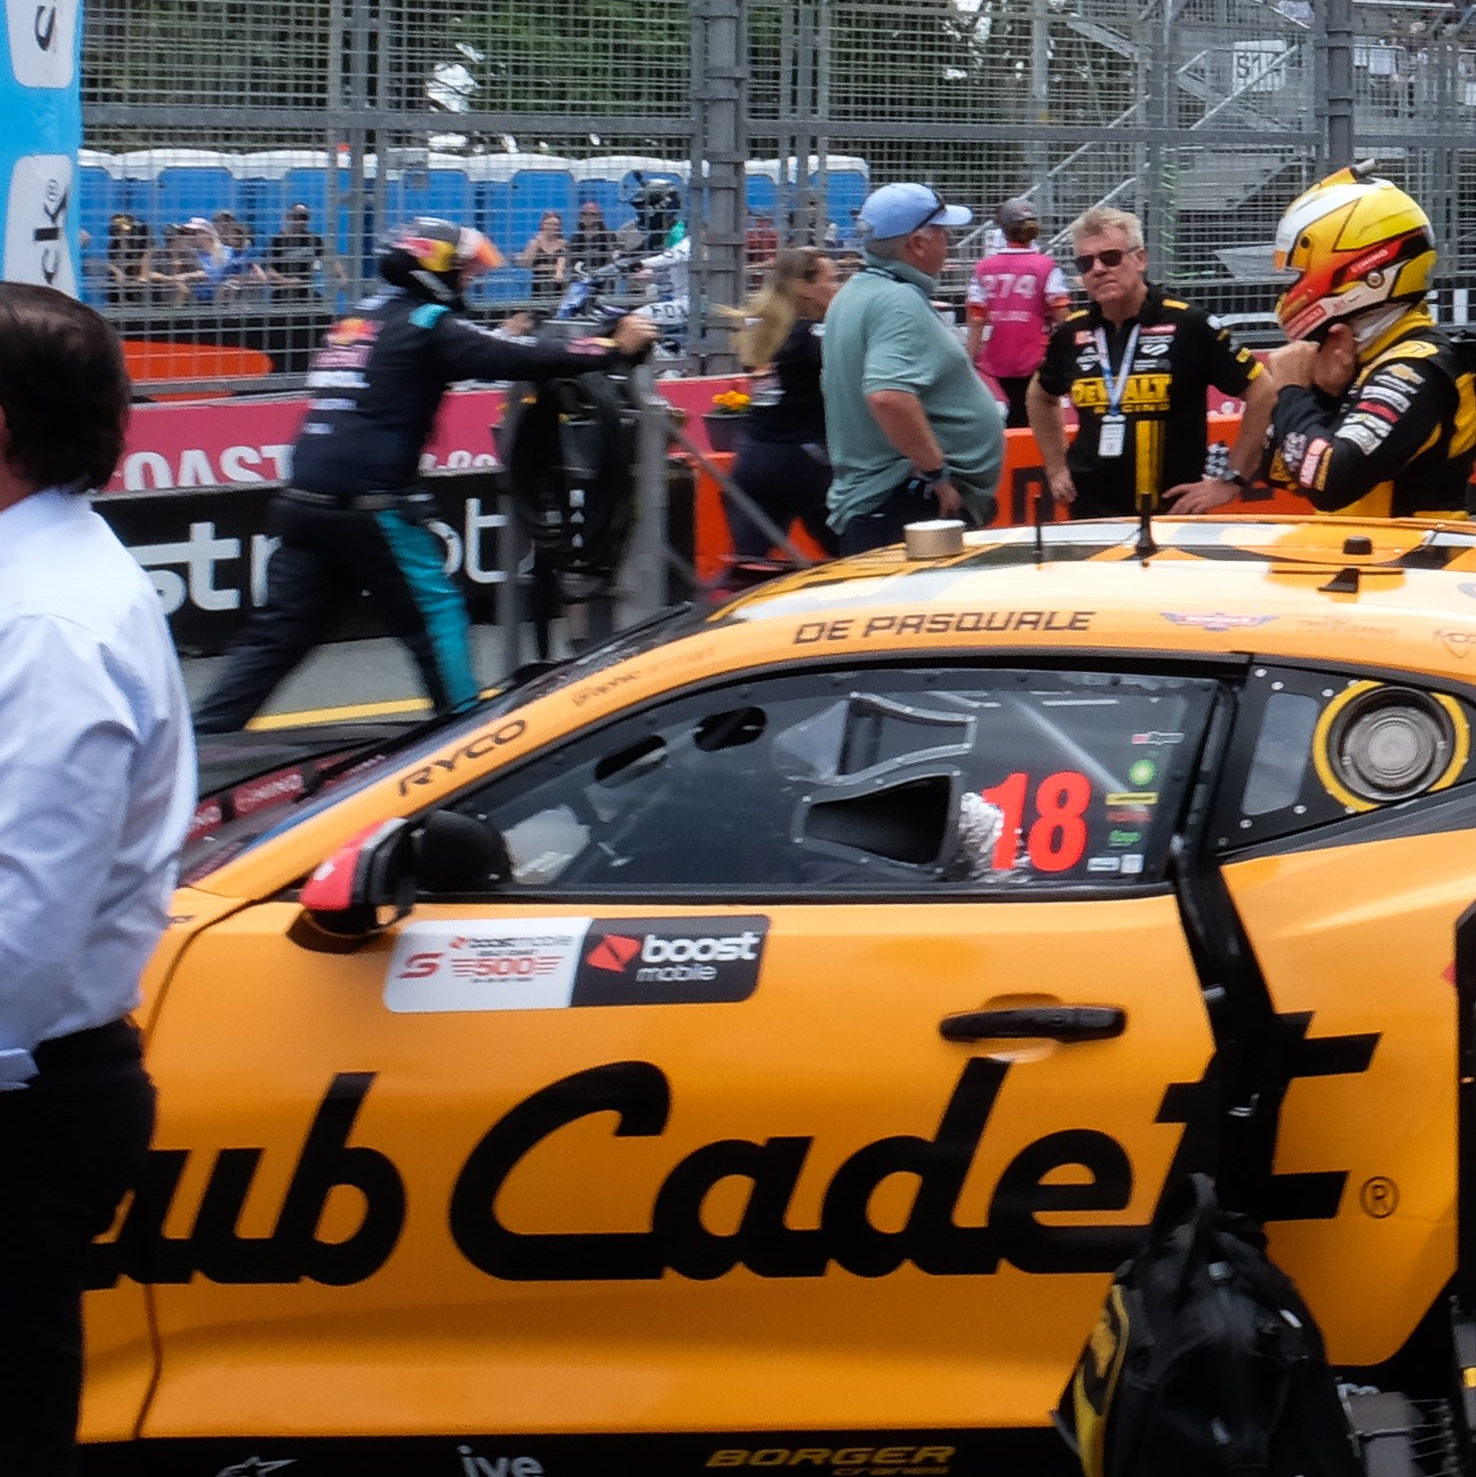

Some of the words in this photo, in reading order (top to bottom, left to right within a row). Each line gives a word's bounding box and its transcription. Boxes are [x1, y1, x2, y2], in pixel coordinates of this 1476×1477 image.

[793, 619, 855, 645] DE
[865, 610, 1097, 639] PASQUALE
[399, 719, 528, 797] RYCO
[981, 770, 1092, 872] 18
[641, 931, 761, 964] boost
[635, 964, 718, 984] mobile
[705, 1445, 957, 1469] BORGER
